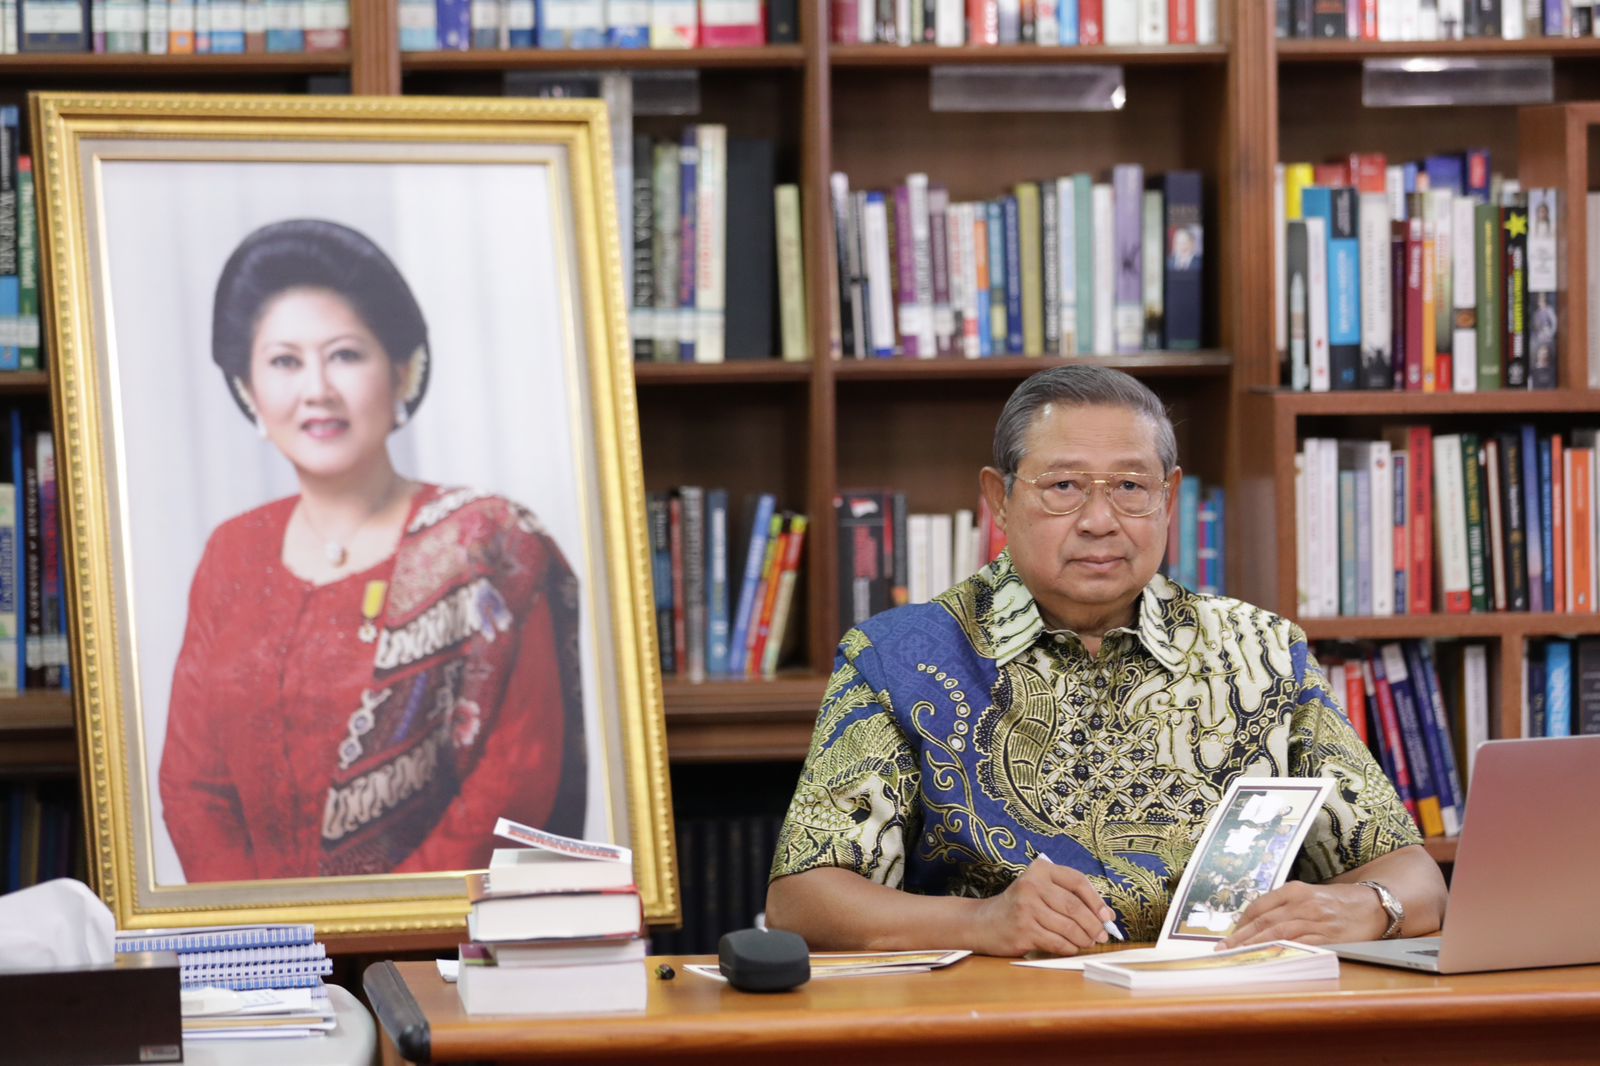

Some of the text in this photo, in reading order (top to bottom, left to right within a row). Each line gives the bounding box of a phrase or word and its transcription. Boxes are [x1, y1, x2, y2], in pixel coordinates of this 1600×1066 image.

[0, 190, 15, 275] WARFARE
[20, 183, 35, 288] The Living World
